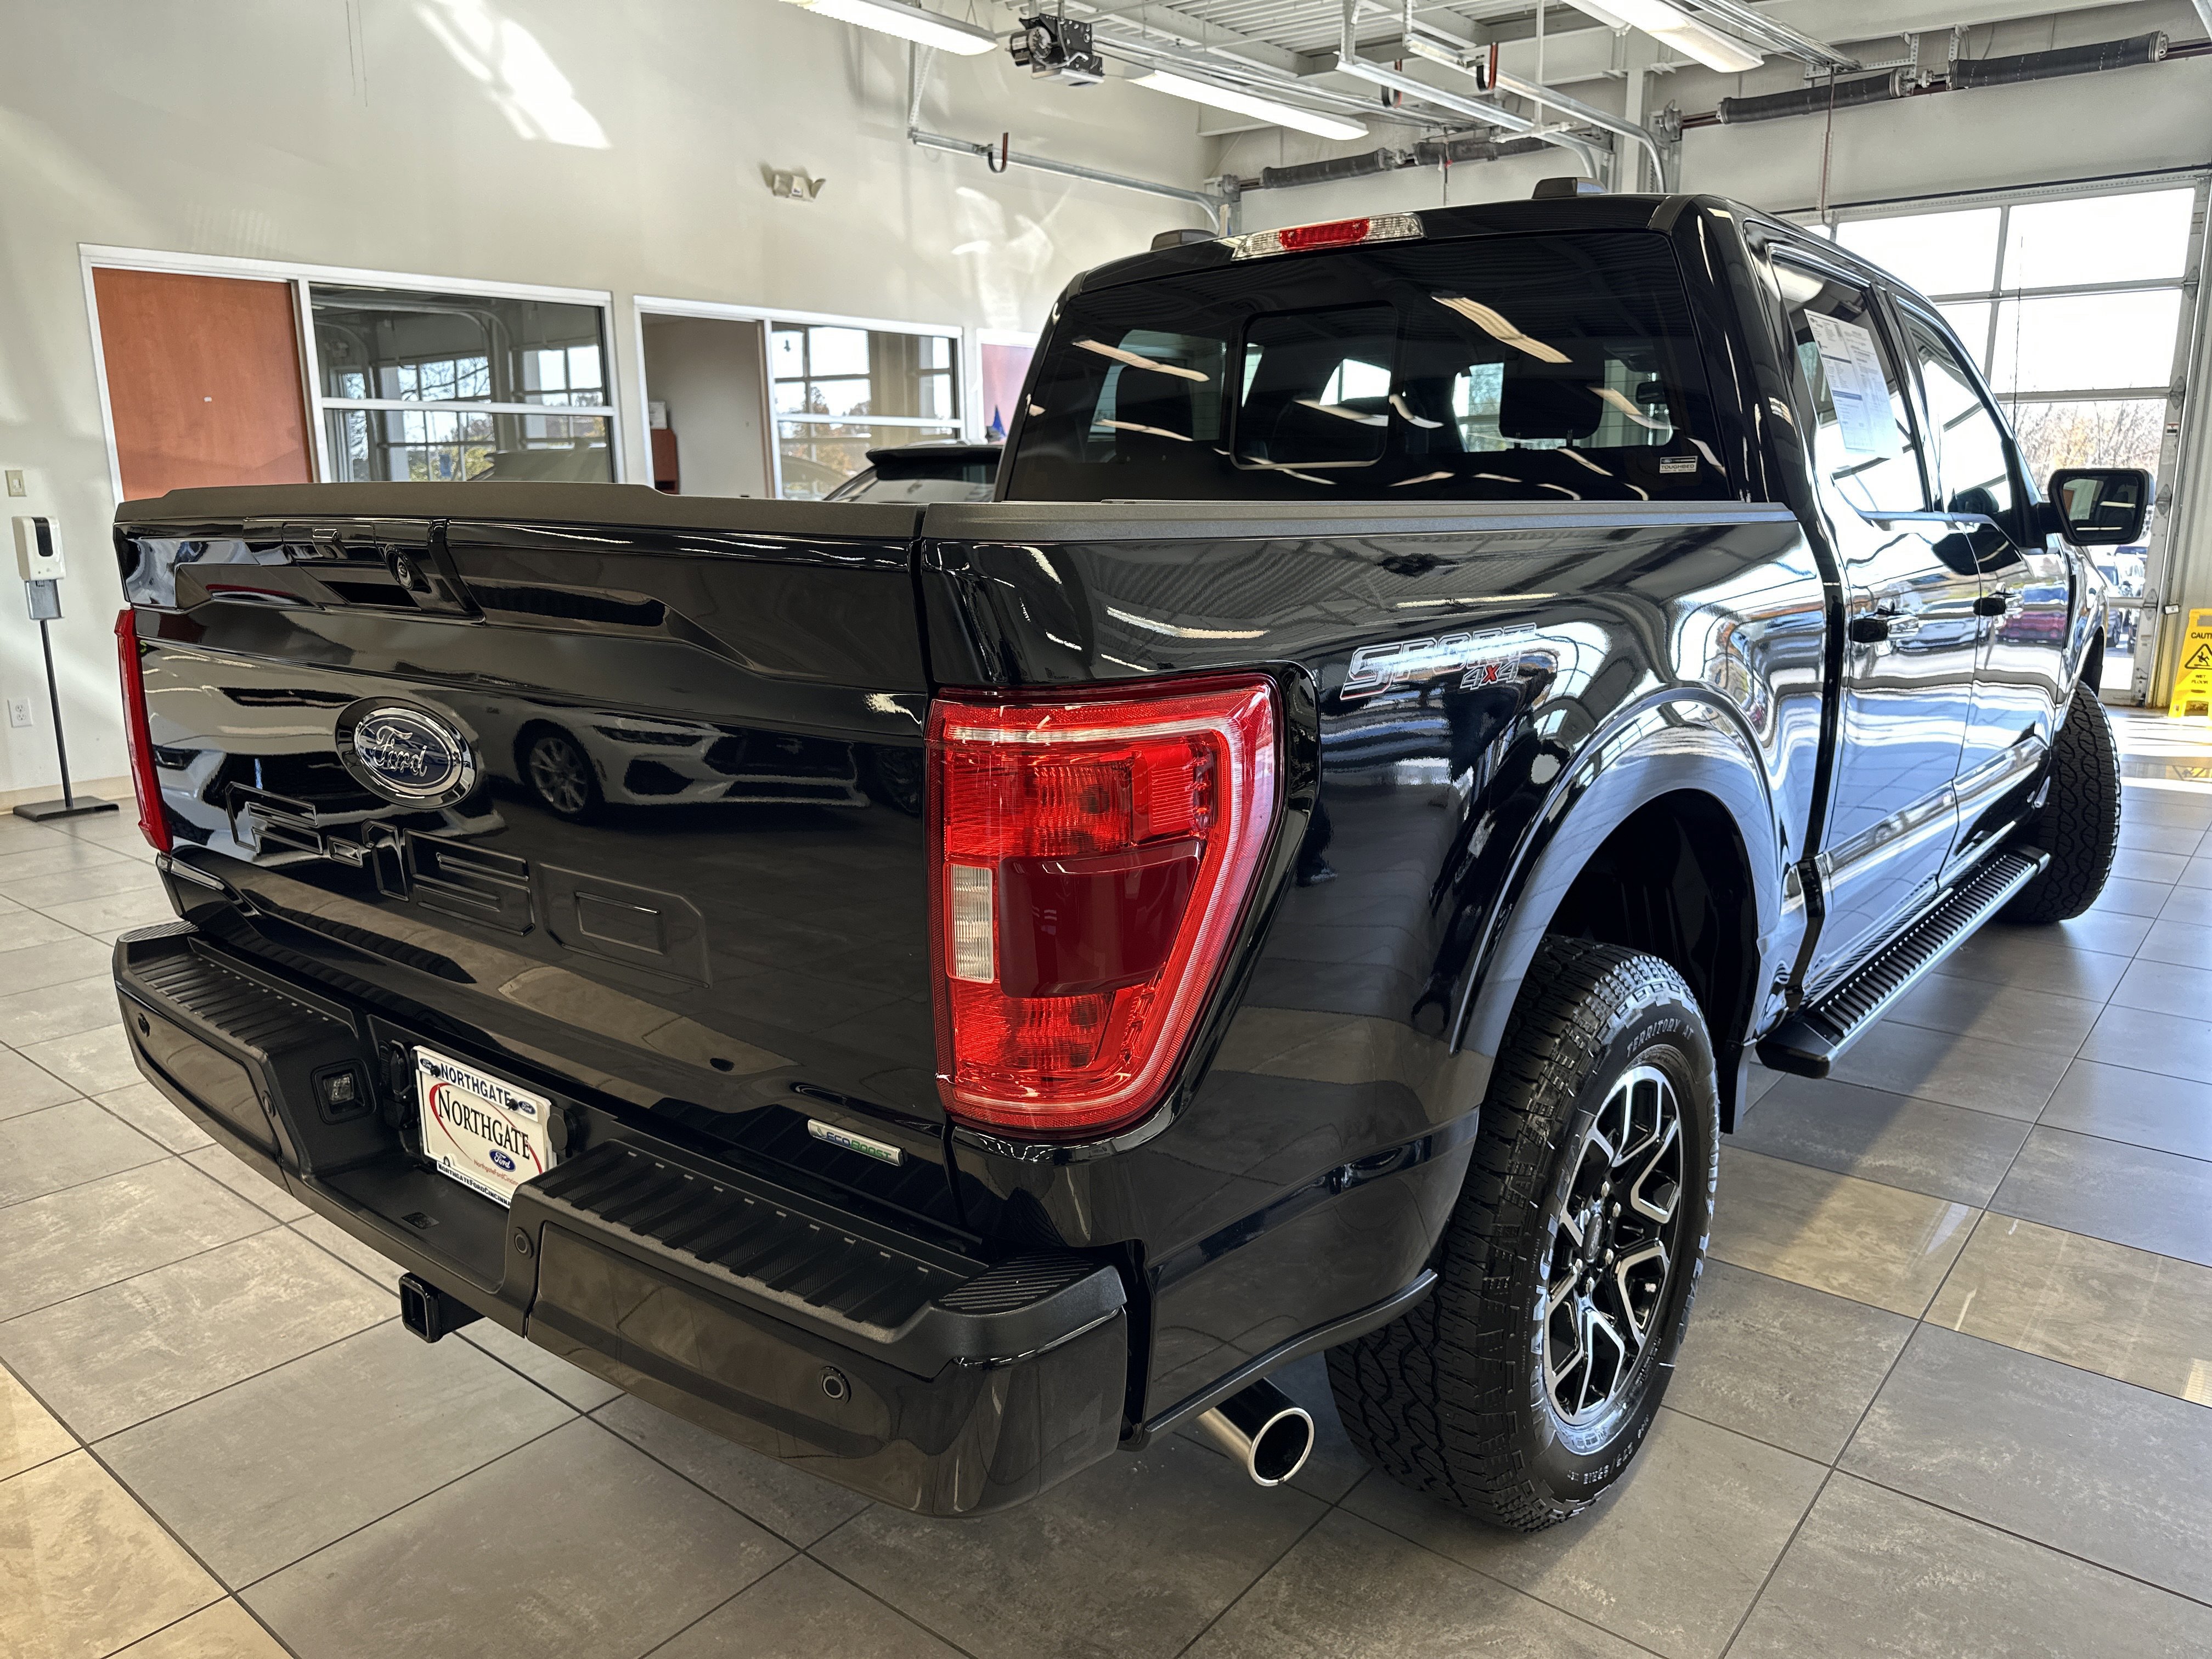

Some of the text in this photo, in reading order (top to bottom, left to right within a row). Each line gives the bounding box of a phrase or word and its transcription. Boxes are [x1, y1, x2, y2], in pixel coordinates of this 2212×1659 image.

[1340, 622, 1537, 701] SPORT
[373, 725, 427, 777] Ford
[225, 781, 713, 988] F-150
[1627, 1018, 1694, 1058] TERRITORY AT
[441, 1063, 512, 1106] NORTHGATE
[438, 1086, 530, 1160] NORTHGATE
[826, 1131, 891, 1159] ECOBOOST
